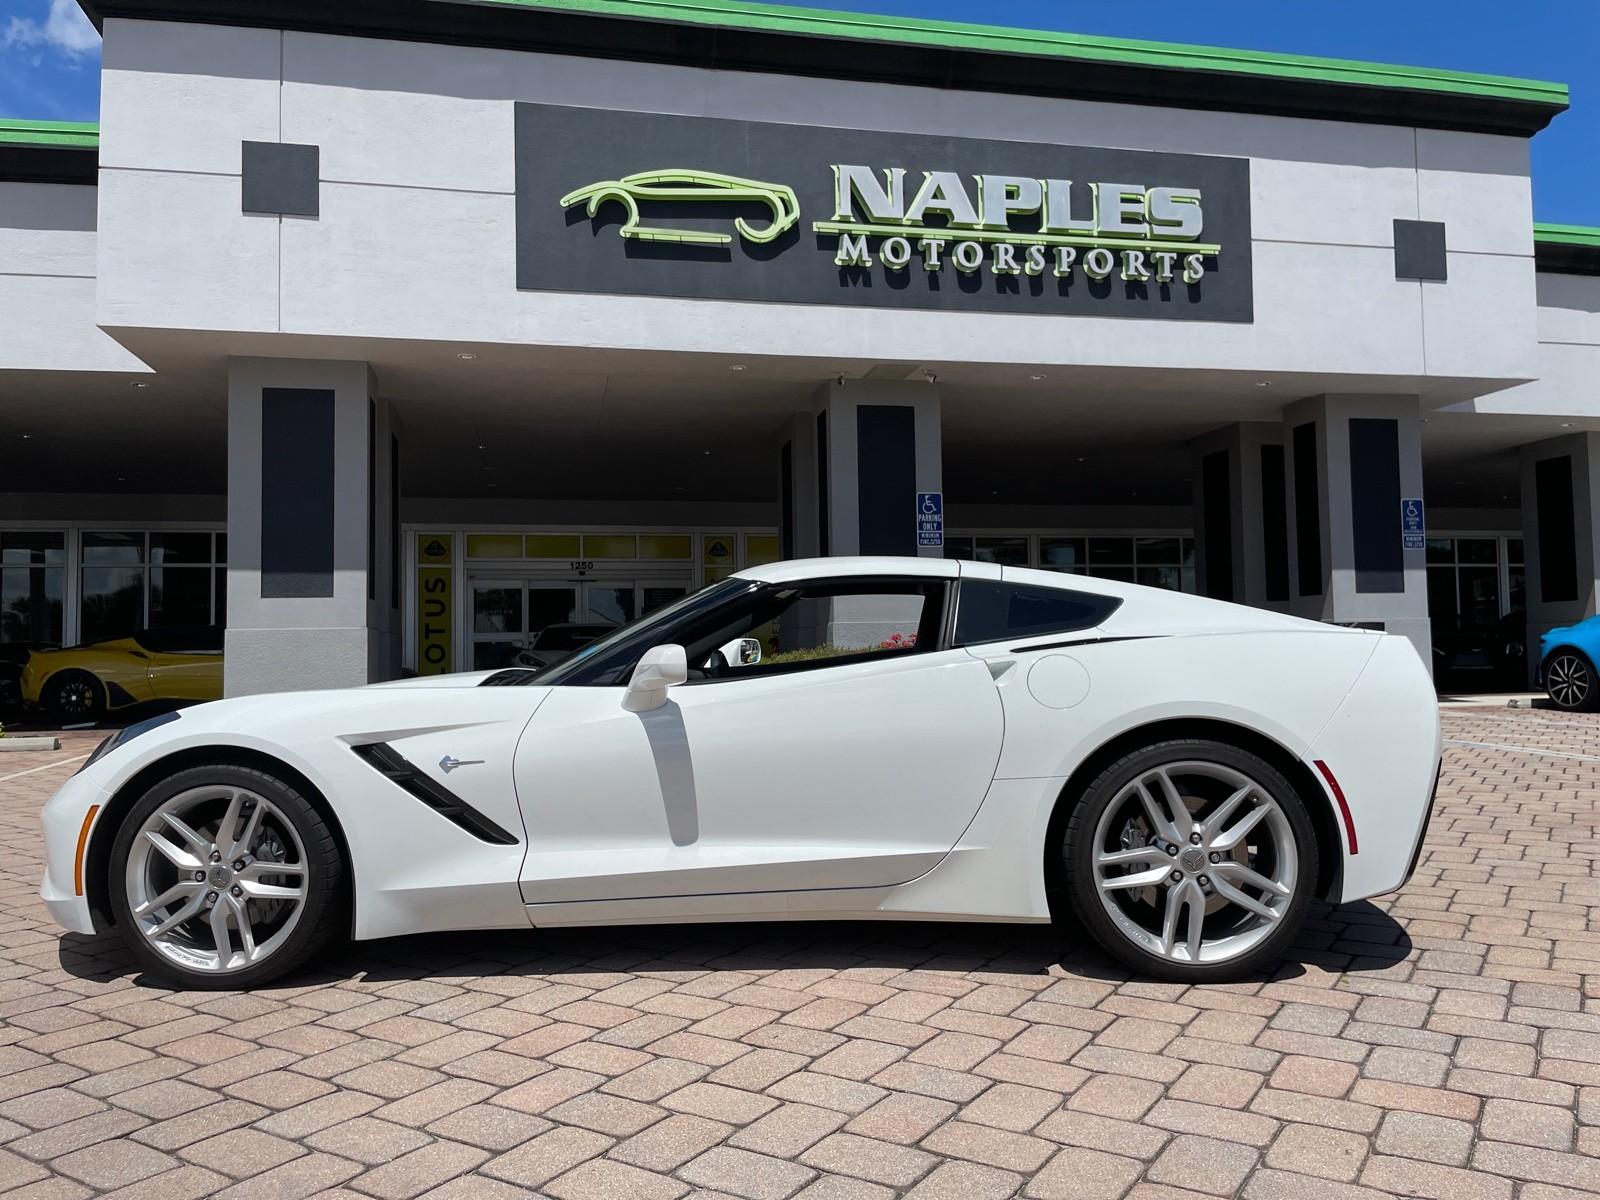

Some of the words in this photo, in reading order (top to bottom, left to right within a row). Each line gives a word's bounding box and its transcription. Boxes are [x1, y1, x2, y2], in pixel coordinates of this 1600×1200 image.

[830, 164, 1203, 241] NAPLES
[834, 233, 1204, 284] MOTORSPORTS
[918, 514, 942, 522] PARKING
[922, 522, 938, 531] ONLY
[569, 561, 594, 570] 1250
[424, 577, 446, 674] OTUS
